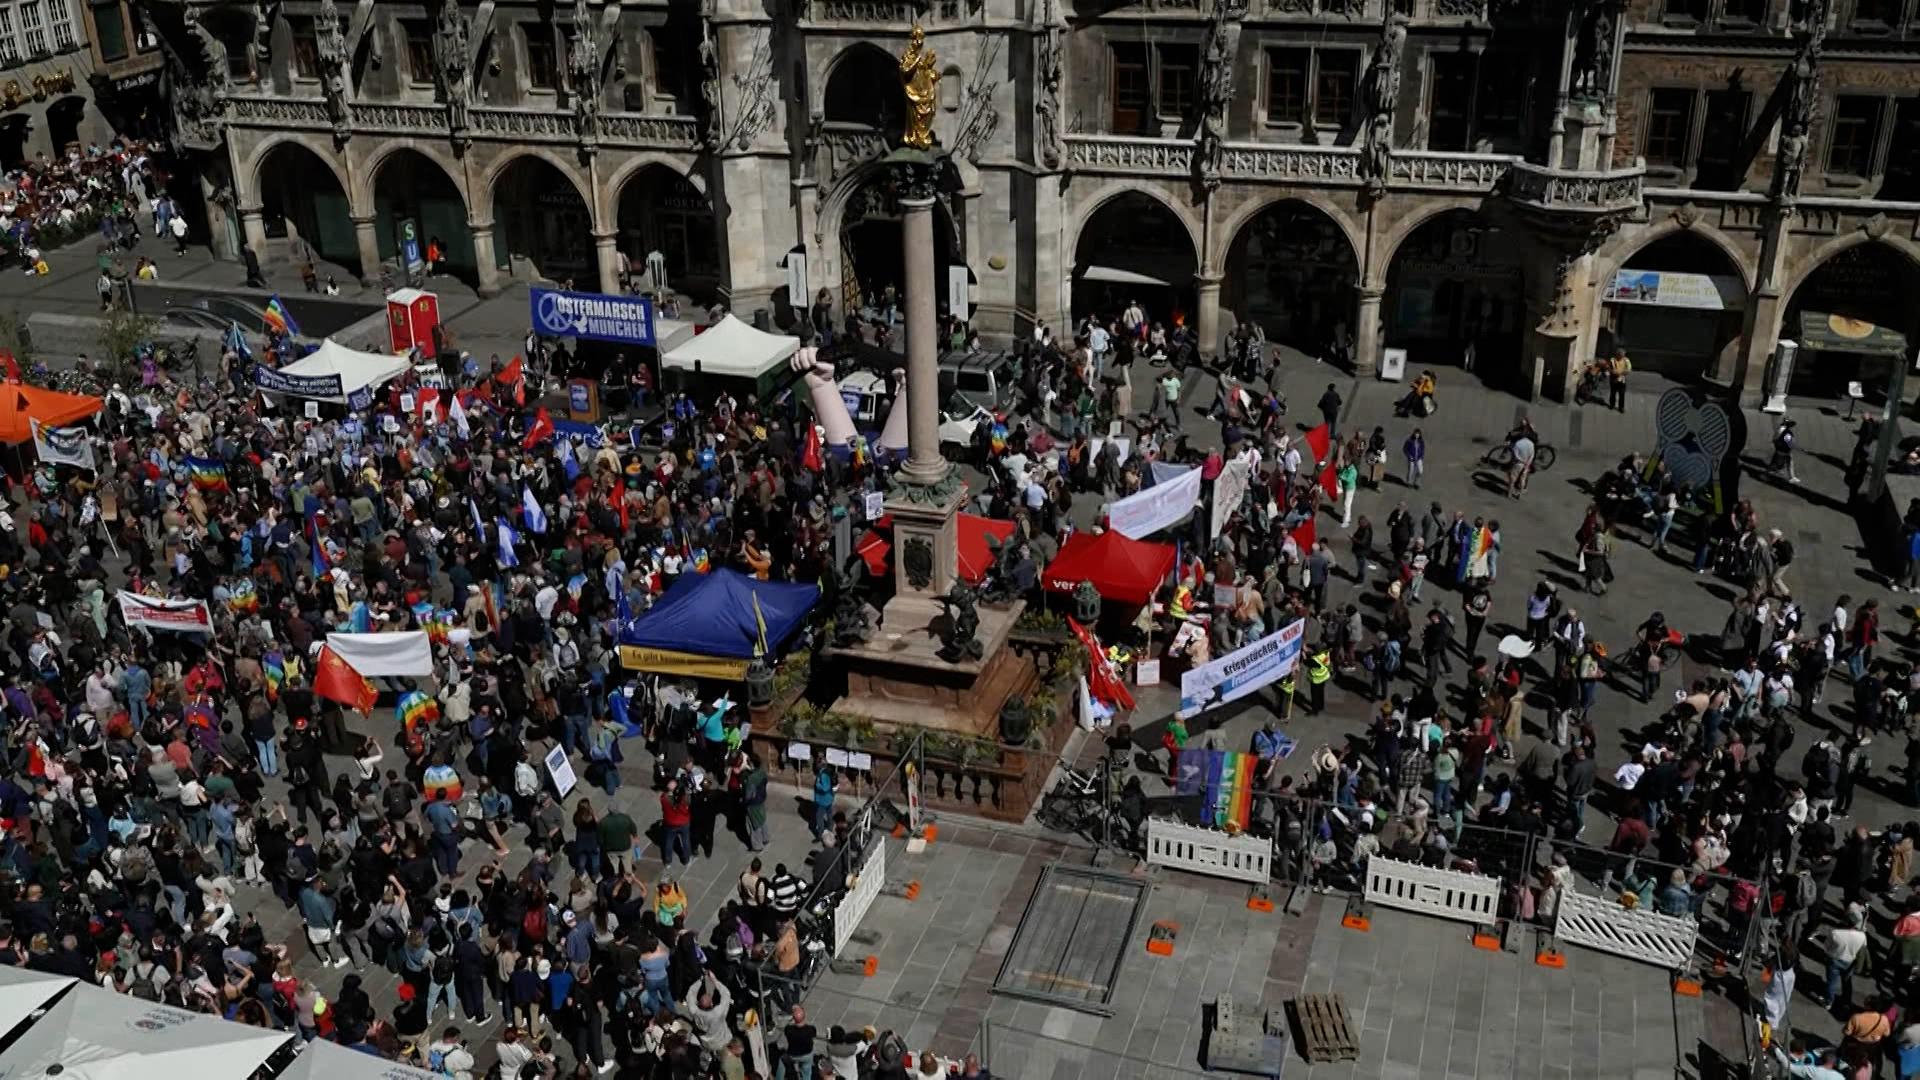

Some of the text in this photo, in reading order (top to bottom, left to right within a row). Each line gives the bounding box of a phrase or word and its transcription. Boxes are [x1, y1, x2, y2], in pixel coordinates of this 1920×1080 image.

[405, 223, 414, 240] S
[408, 243, 416, 260] U
[557, 297, 645, 320] OSTERMARSCH
